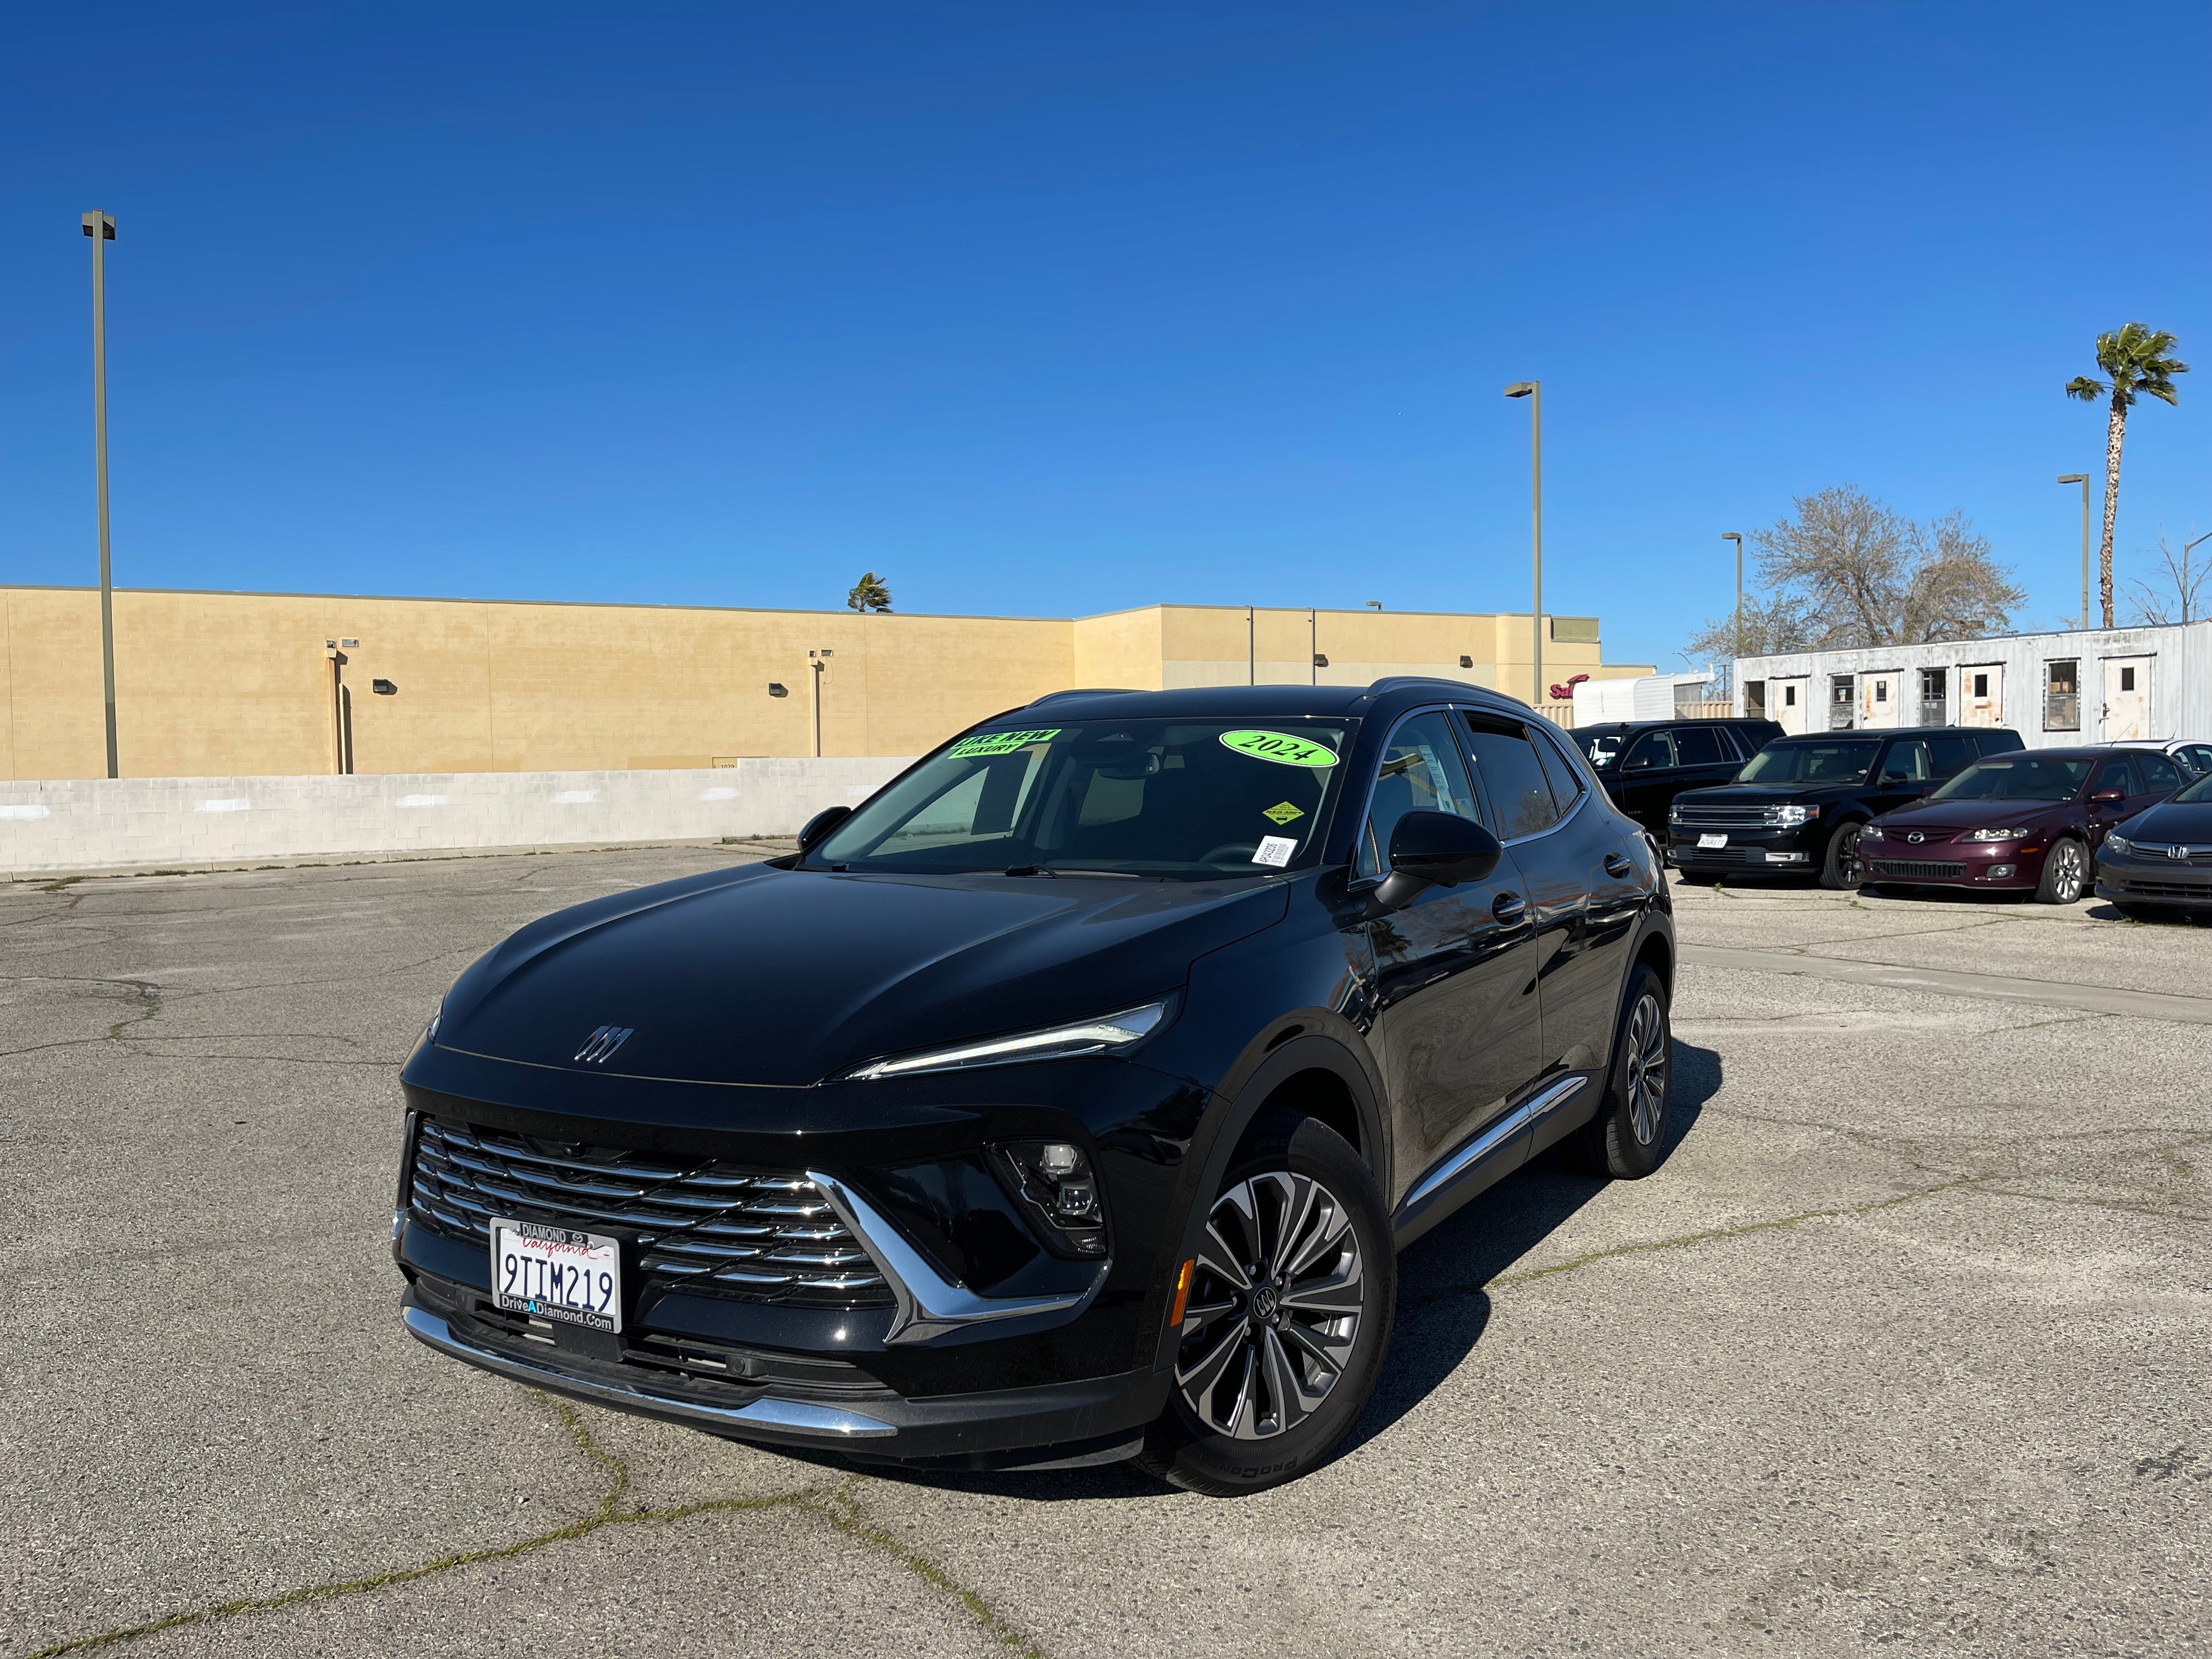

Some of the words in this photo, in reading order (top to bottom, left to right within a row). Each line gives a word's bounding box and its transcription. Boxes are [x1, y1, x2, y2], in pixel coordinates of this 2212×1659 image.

[954, 733, 1003, 747] LIKE
[998, 730, 1056, 741] NEW
[956, 743, 1019, 755] LUXURY
[1238, 735, 1319, 760] 2024
[522, 1223, 566, 1243] DIAMOND
[503, 1253, 613, 1313] 9TIM219
[501, 1295, 612, 1330] DriveADiamond.Com
